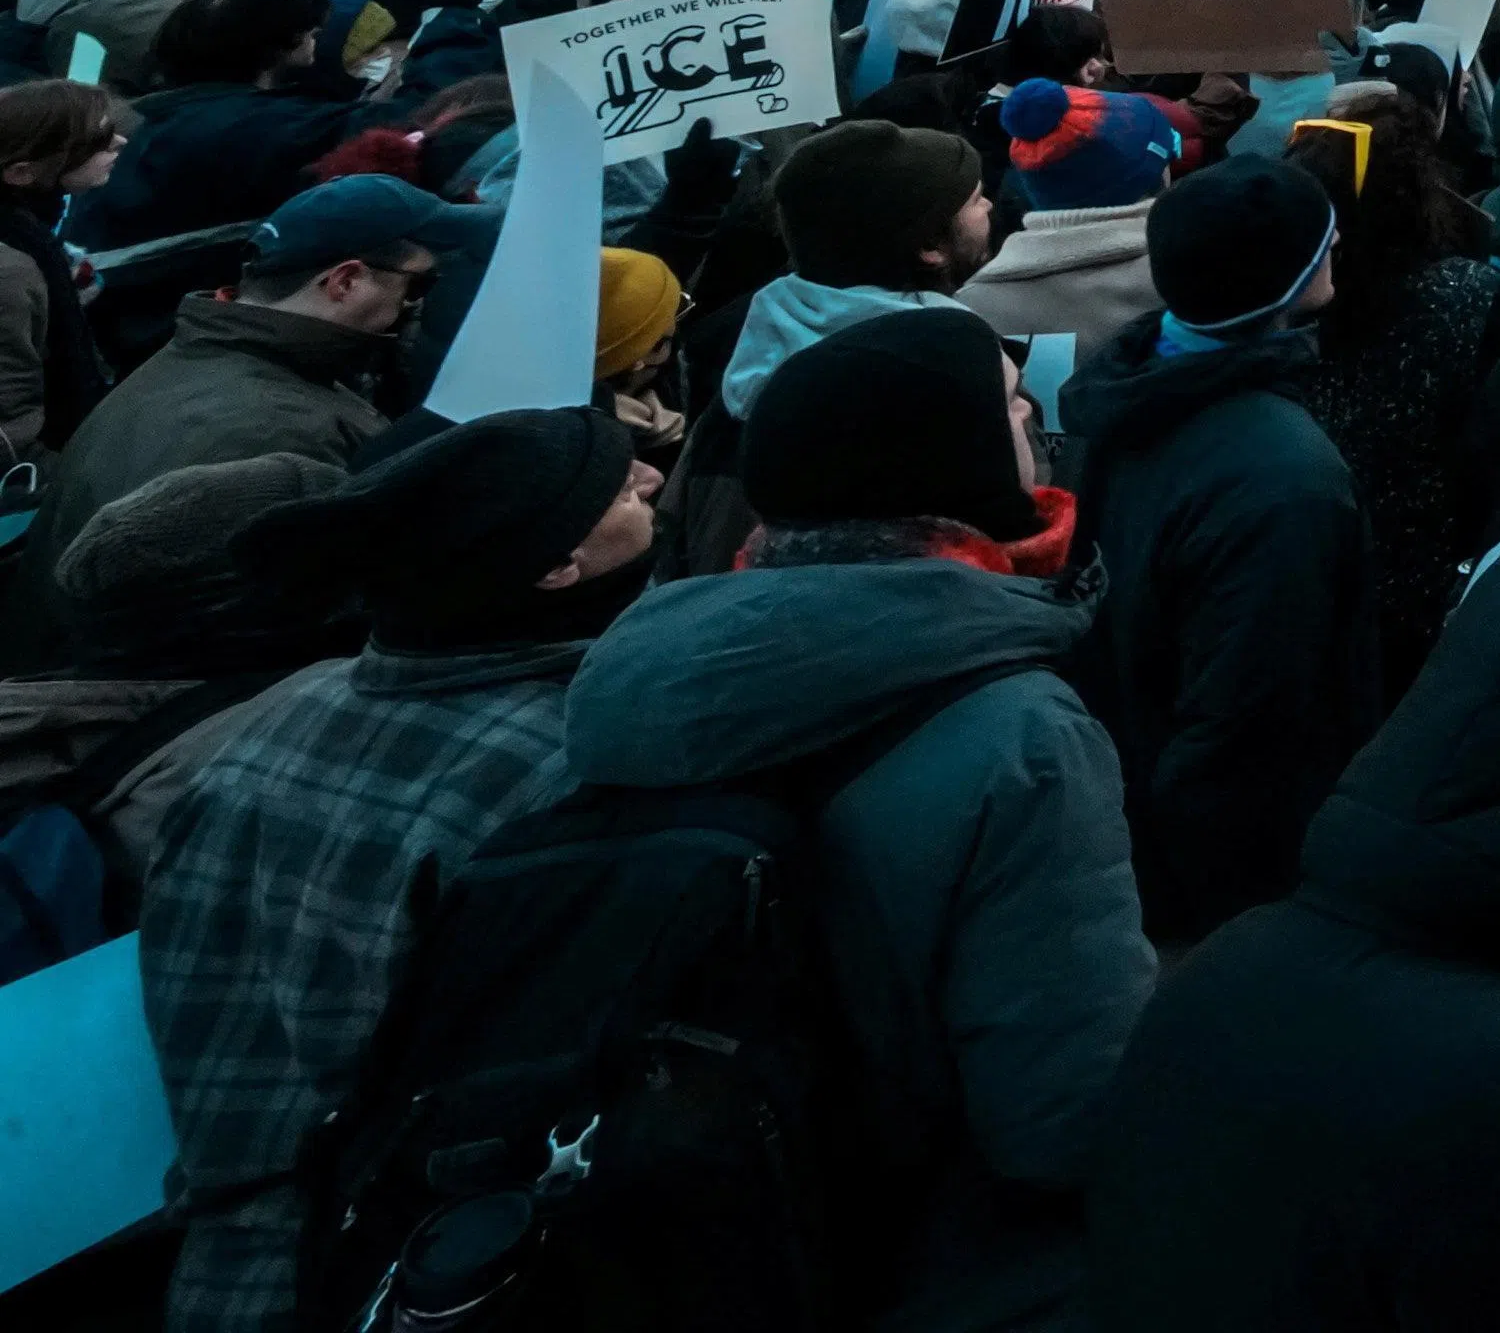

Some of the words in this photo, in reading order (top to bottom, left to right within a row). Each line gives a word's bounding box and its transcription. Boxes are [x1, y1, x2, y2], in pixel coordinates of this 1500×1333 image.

[560, 8, 666, 49] TOGETHER
[672, 0, 700, 15] WE
[603, 14, 774, 109] ICE
